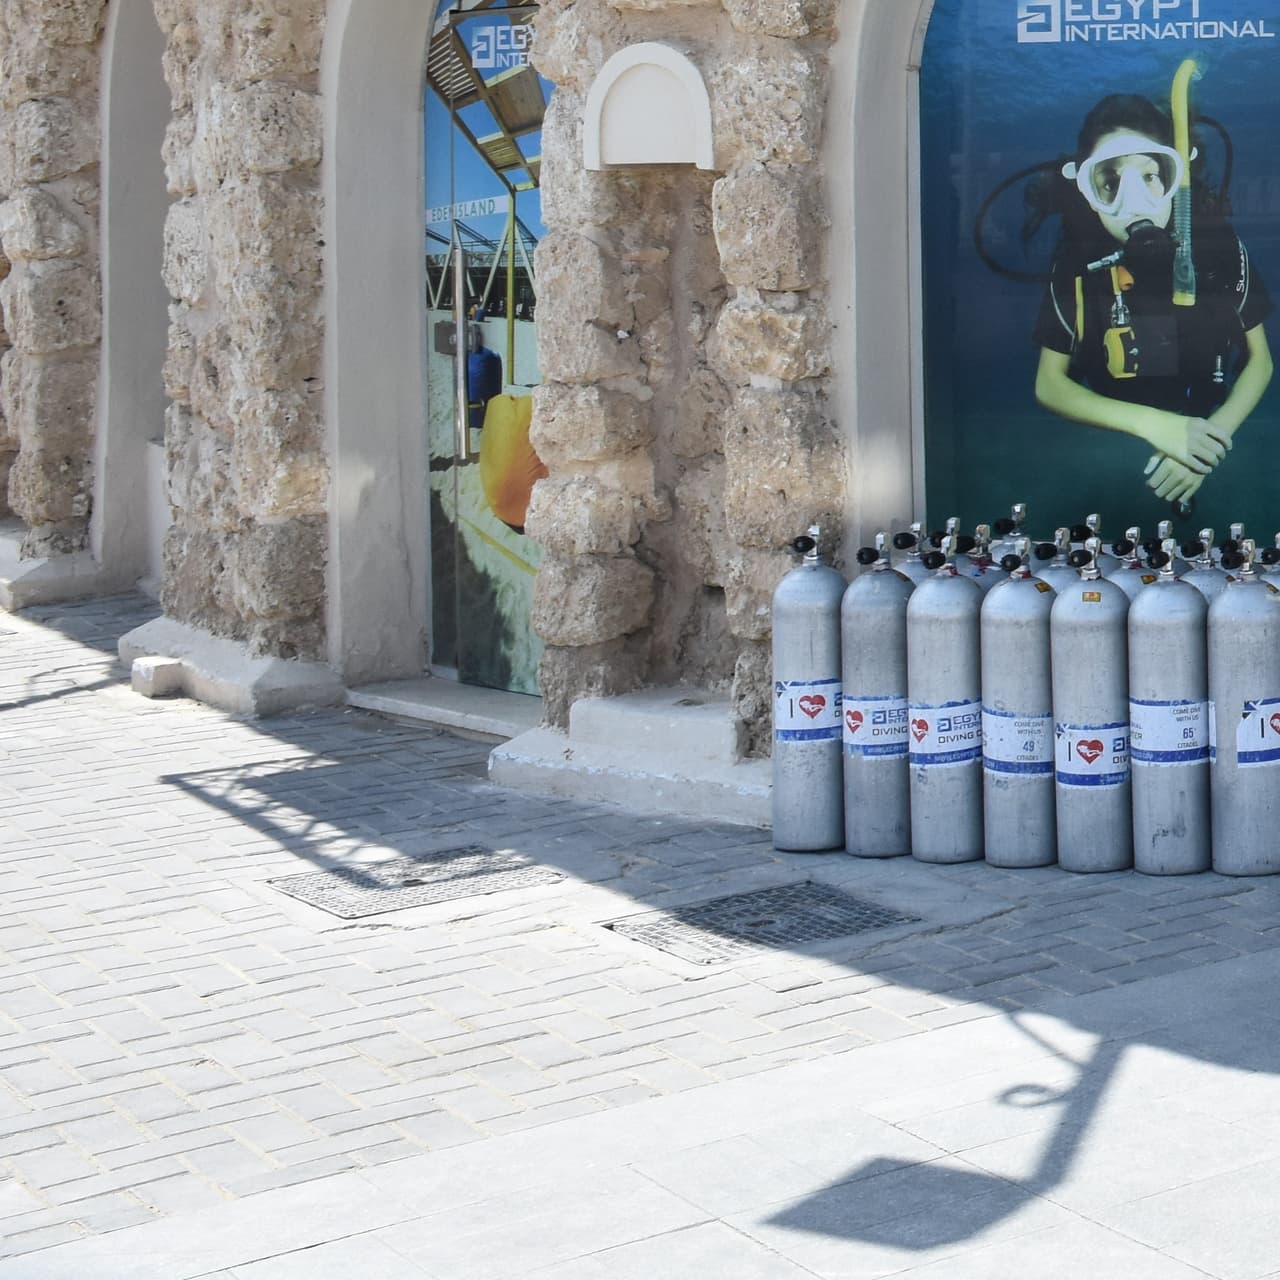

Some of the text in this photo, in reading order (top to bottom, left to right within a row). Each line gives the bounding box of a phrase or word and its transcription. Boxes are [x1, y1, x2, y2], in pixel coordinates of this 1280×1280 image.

[1065, 20, 1275, 42] INTERNATIONAL
[496, 52, 532, 68] INTE
[872, 726, 908, 736] DIVING
[938, 731, 974, 744] DIVING
[1183, 727, 1194, 739] 65
